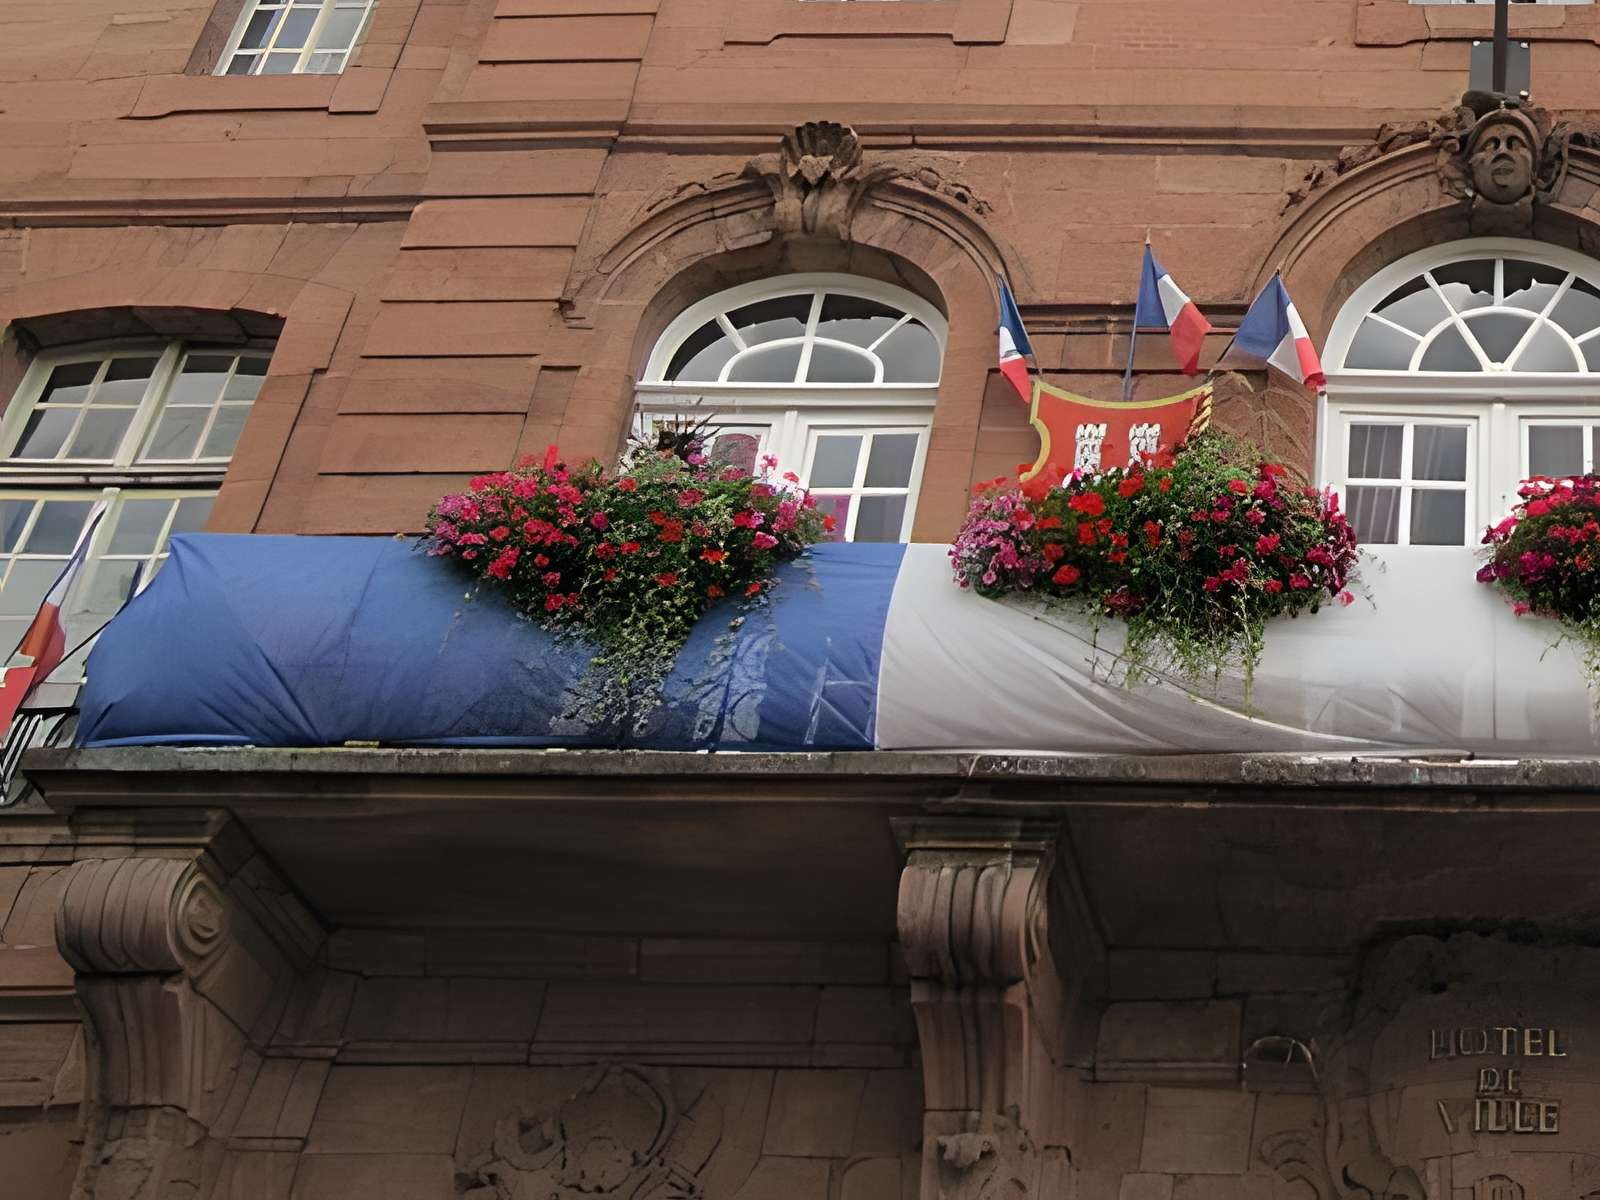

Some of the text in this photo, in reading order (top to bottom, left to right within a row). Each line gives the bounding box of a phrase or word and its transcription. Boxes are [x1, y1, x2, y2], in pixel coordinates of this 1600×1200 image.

[1430, 1026, 1568, 1059] HOTEL
[1477, 1067, 1522, 1092] DE
[1435, 1098, 1561, 1134] VILLE
